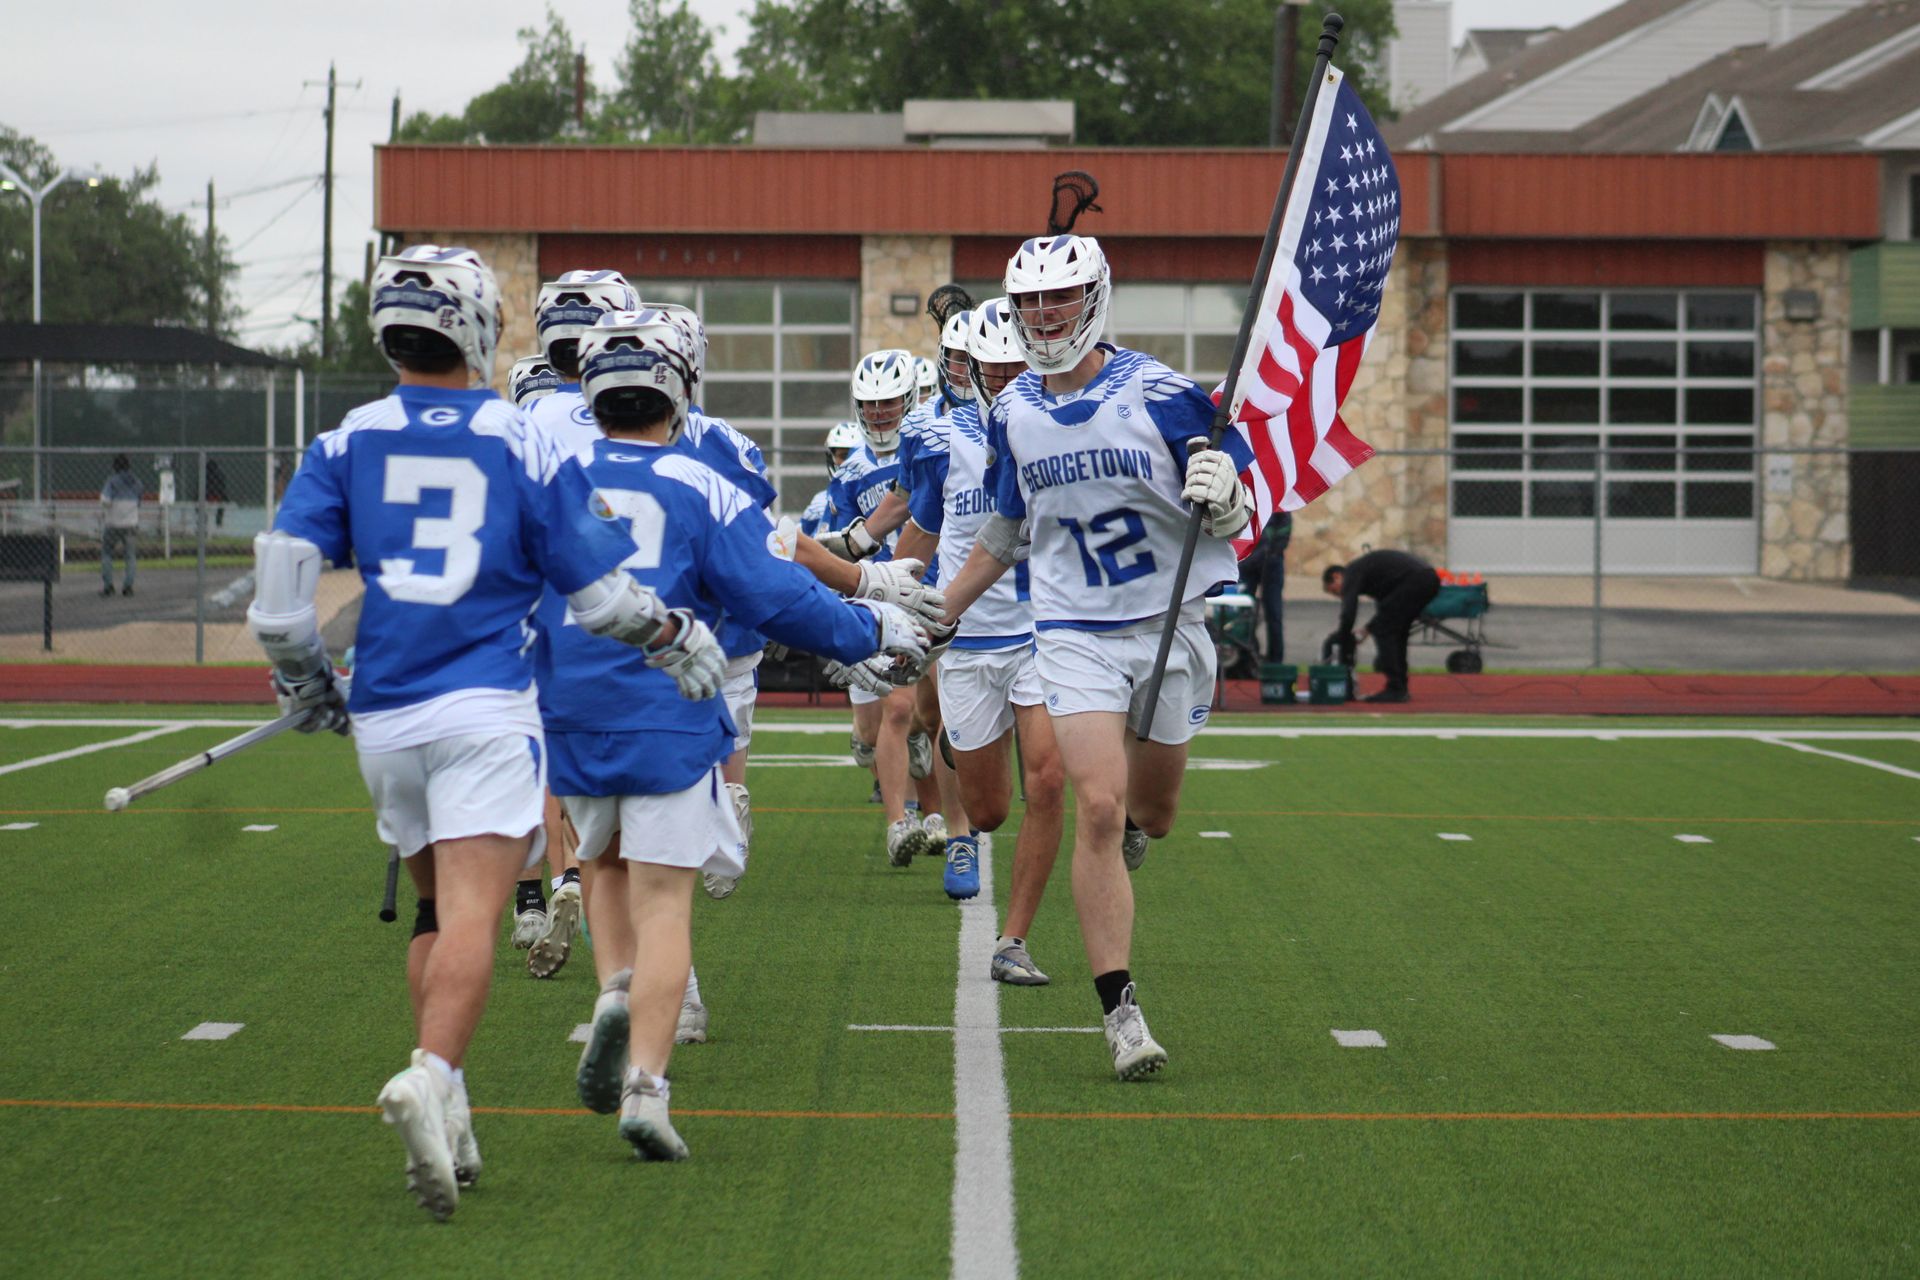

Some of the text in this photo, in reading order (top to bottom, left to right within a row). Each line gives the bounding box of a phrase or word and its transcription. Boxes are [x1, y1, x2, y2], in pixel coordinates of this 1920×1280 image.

[654, 374, 667, 384] 12
[420, 406, 462, 427] G
[1022, 448, 1153, 493] GEORGETOWN
[955, 487, 998, 516] GEOR
[378, 455, 488, 605] 3
[1058, 507, 1157, 587] 12
[1188, 705, 1210, 724] G
